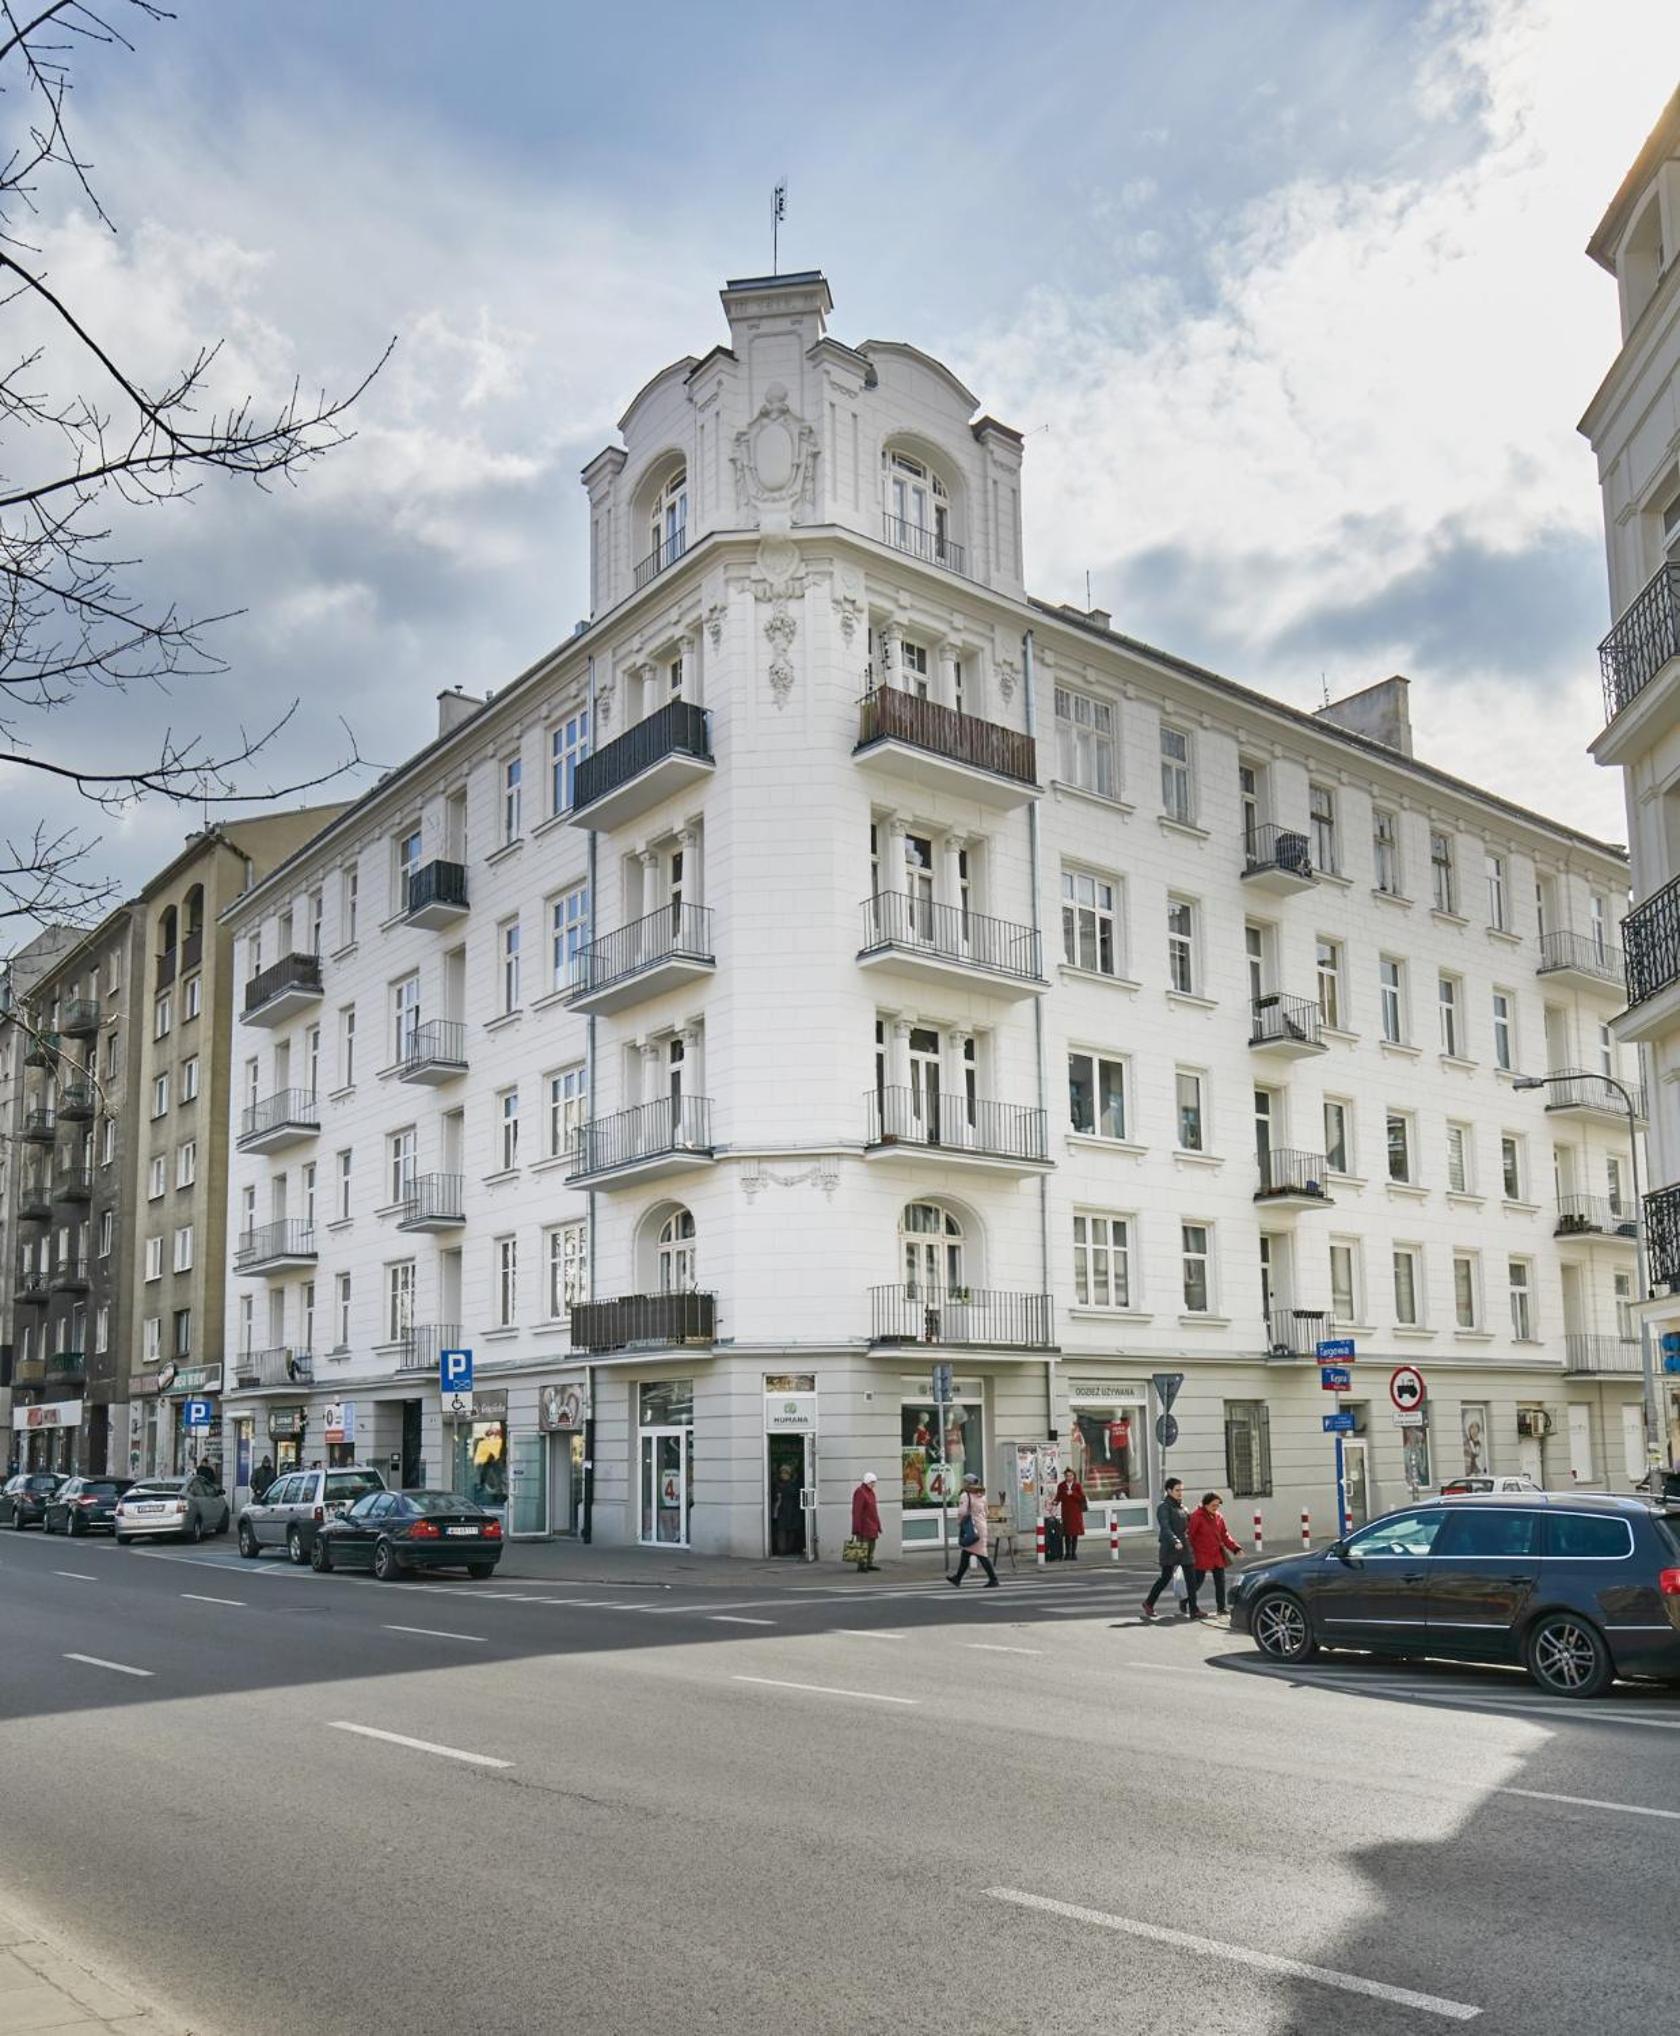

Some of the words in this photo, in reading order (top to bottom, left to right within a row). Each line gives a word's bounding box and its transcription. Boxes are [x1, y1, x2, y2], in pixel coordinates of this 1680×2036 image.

[1320, 1347, 1350, 1358] Targowa
[448, 1354, 466, 1380] P
[190, 1403, 206, 1423] P
[664, 1479, 675, 1500] 4
[930, 1473, 943, 1496] 4
